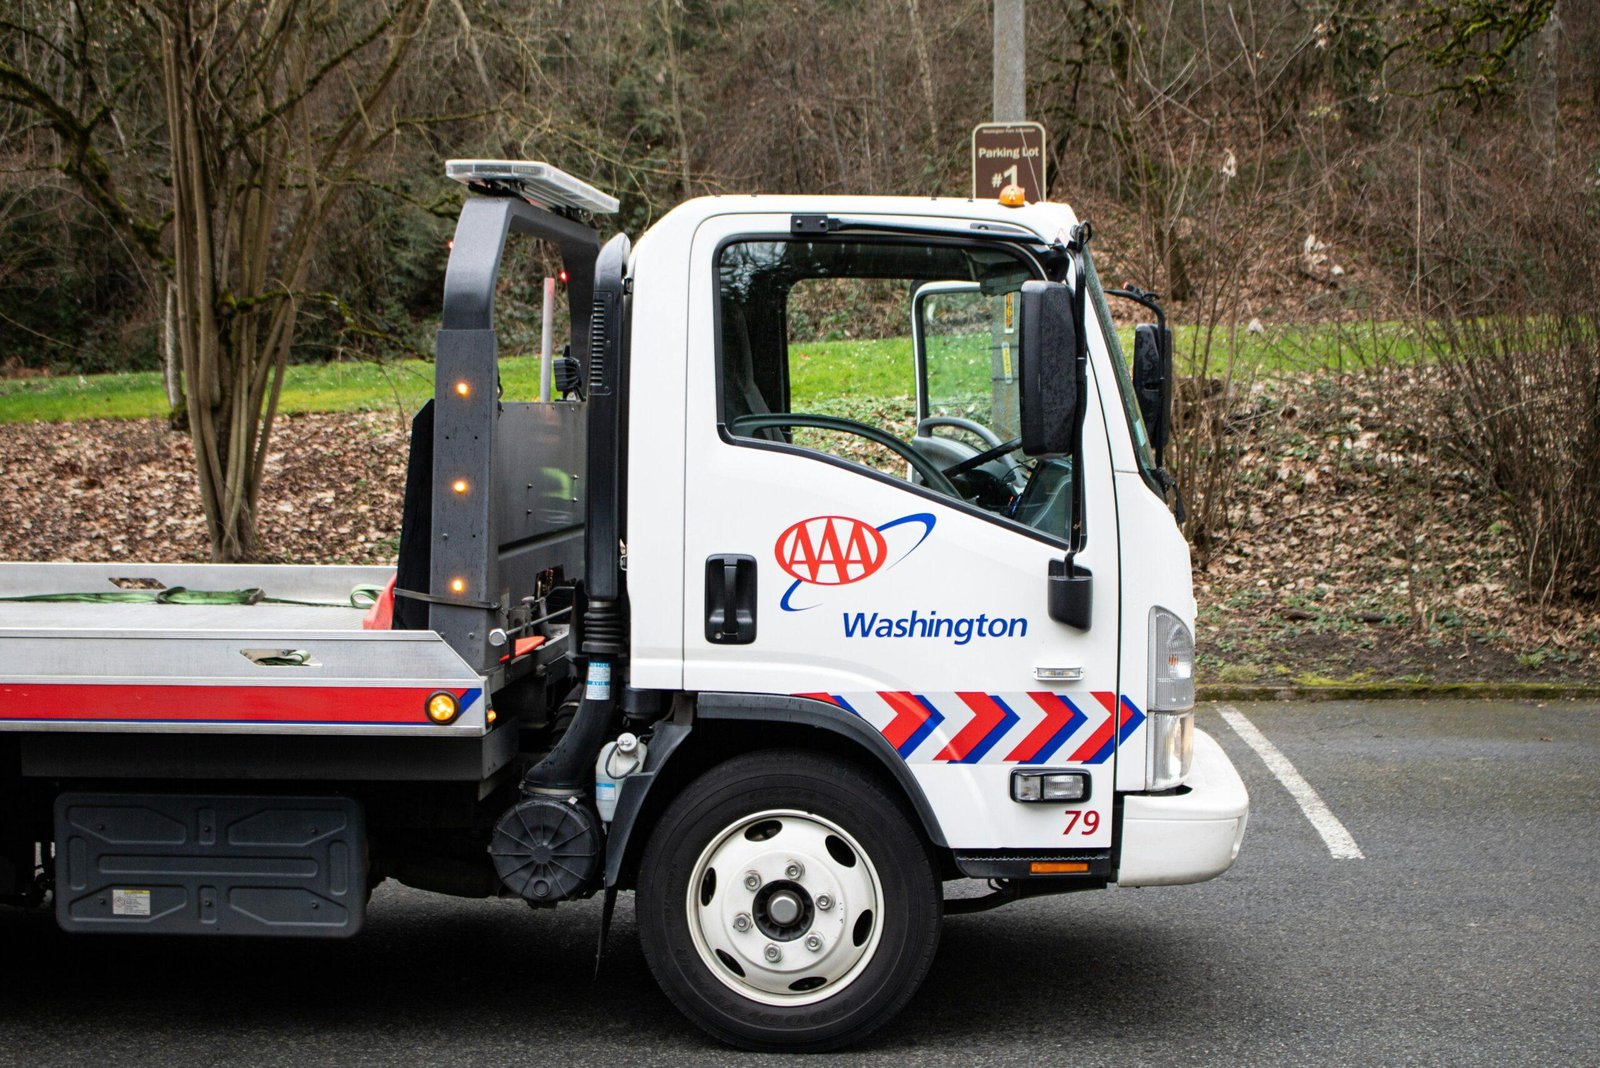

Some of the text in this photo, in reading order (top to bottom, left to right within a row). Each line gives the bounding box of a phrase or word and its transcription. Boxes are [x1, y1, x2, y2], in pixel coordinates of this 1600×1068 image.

[978, 146, 1039, 160] Parking Lot
[991, 164, 1018, 188] #1
[780, 517, 882, 586] AAA
[843, 610, 1028, 645] Washington
[1063, 811, 1100, 836] 79
